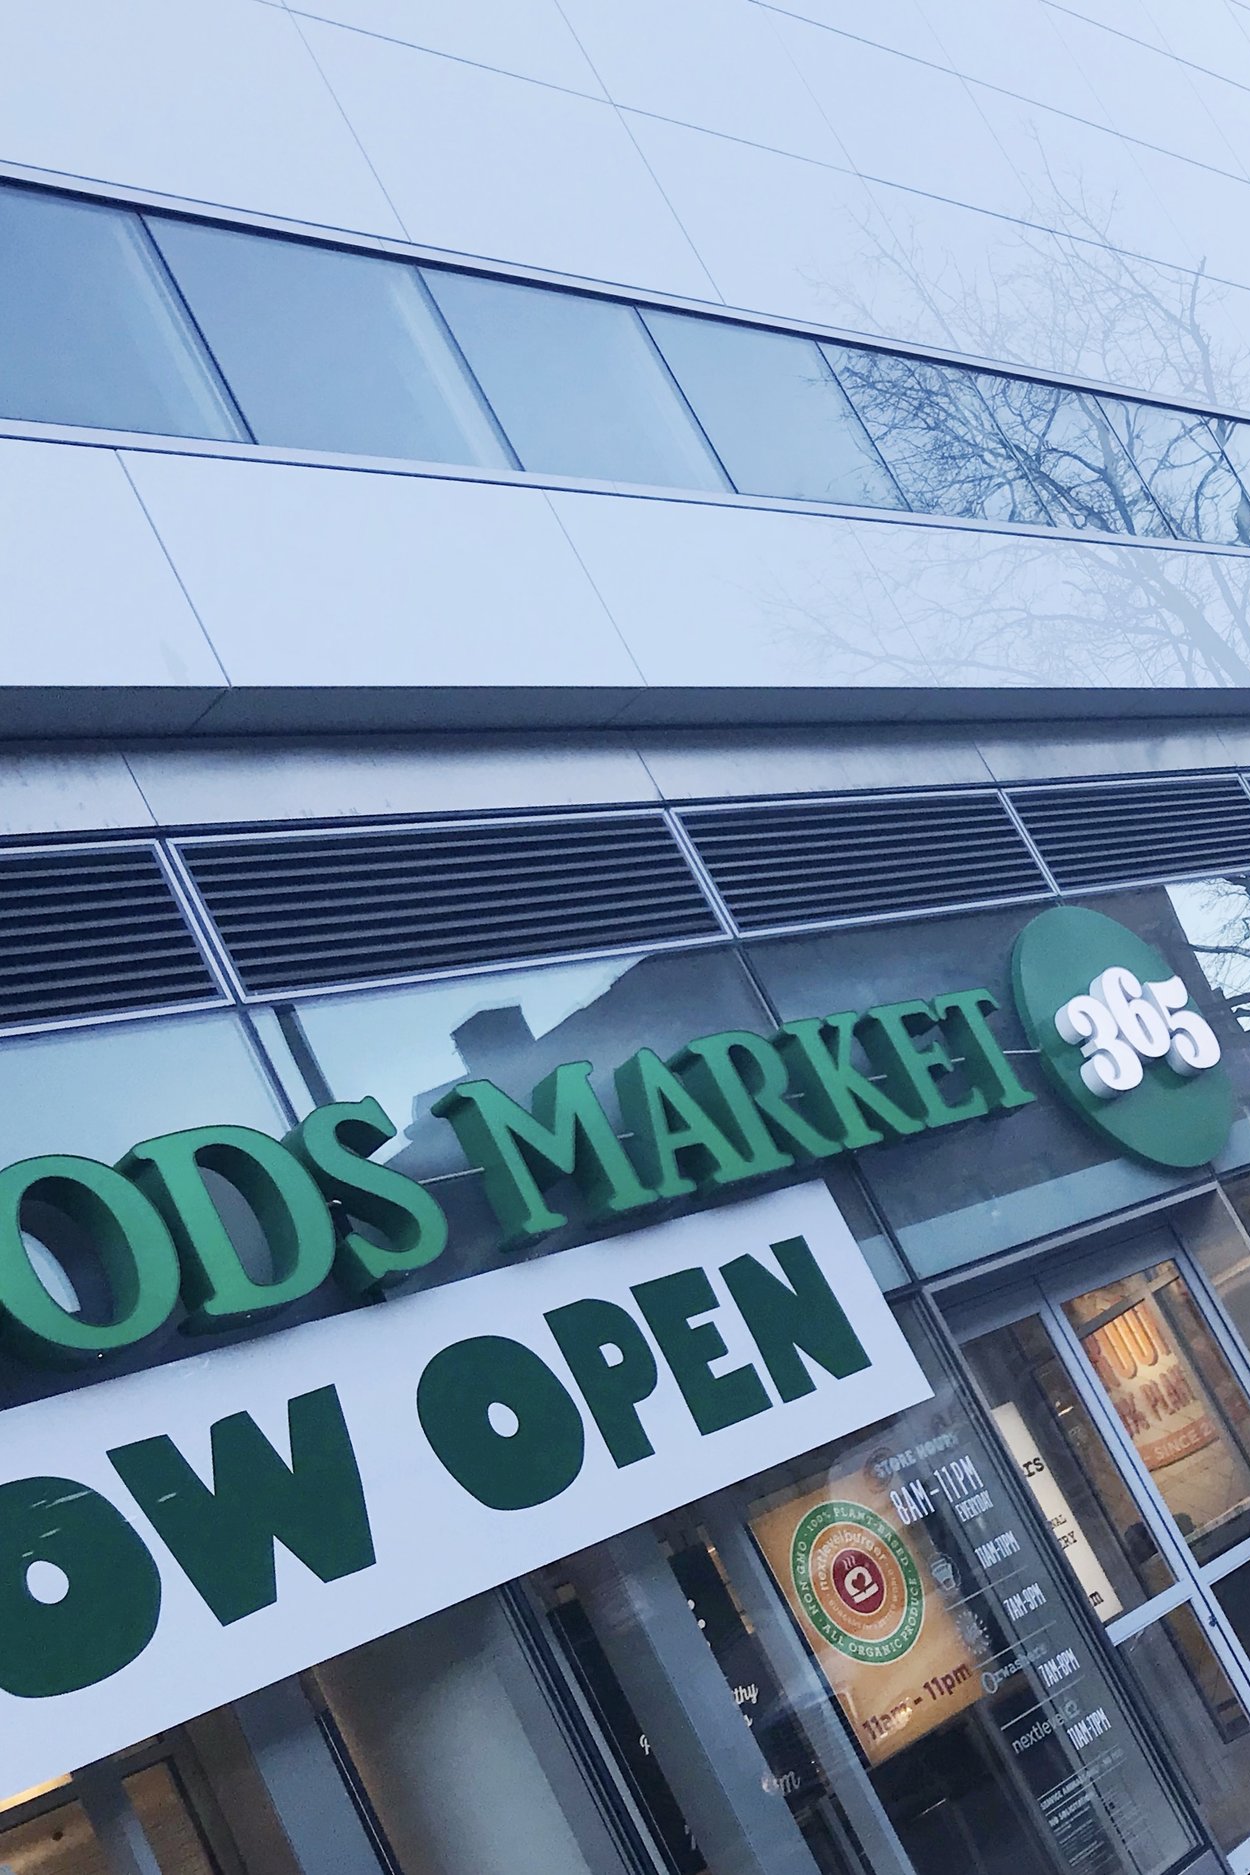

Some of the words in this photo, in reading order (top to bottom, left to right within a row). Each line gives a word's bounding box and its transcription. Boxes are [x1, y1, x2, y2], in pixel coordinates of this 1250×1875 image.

[432, 987, 1037, 1250] MARKET
[1054, 966, 1223, 1099] 365
[416, 1235, 873, 1511] OPEN
[874, 1449, 917, 1479] STORE
[1153, 1433, 1194, 1459] SINCE
[955, 1490, 994, 1523] EVERYDAY
[799, 1580, 820, 1616] NON
[822, 1623, 847, 1646] ALL
[848, 1638, 903, 1658] ORGANIC
[900, 1577, 920, 1642] PRODUCE
[923, 1662, 974, 1703] 11pm
